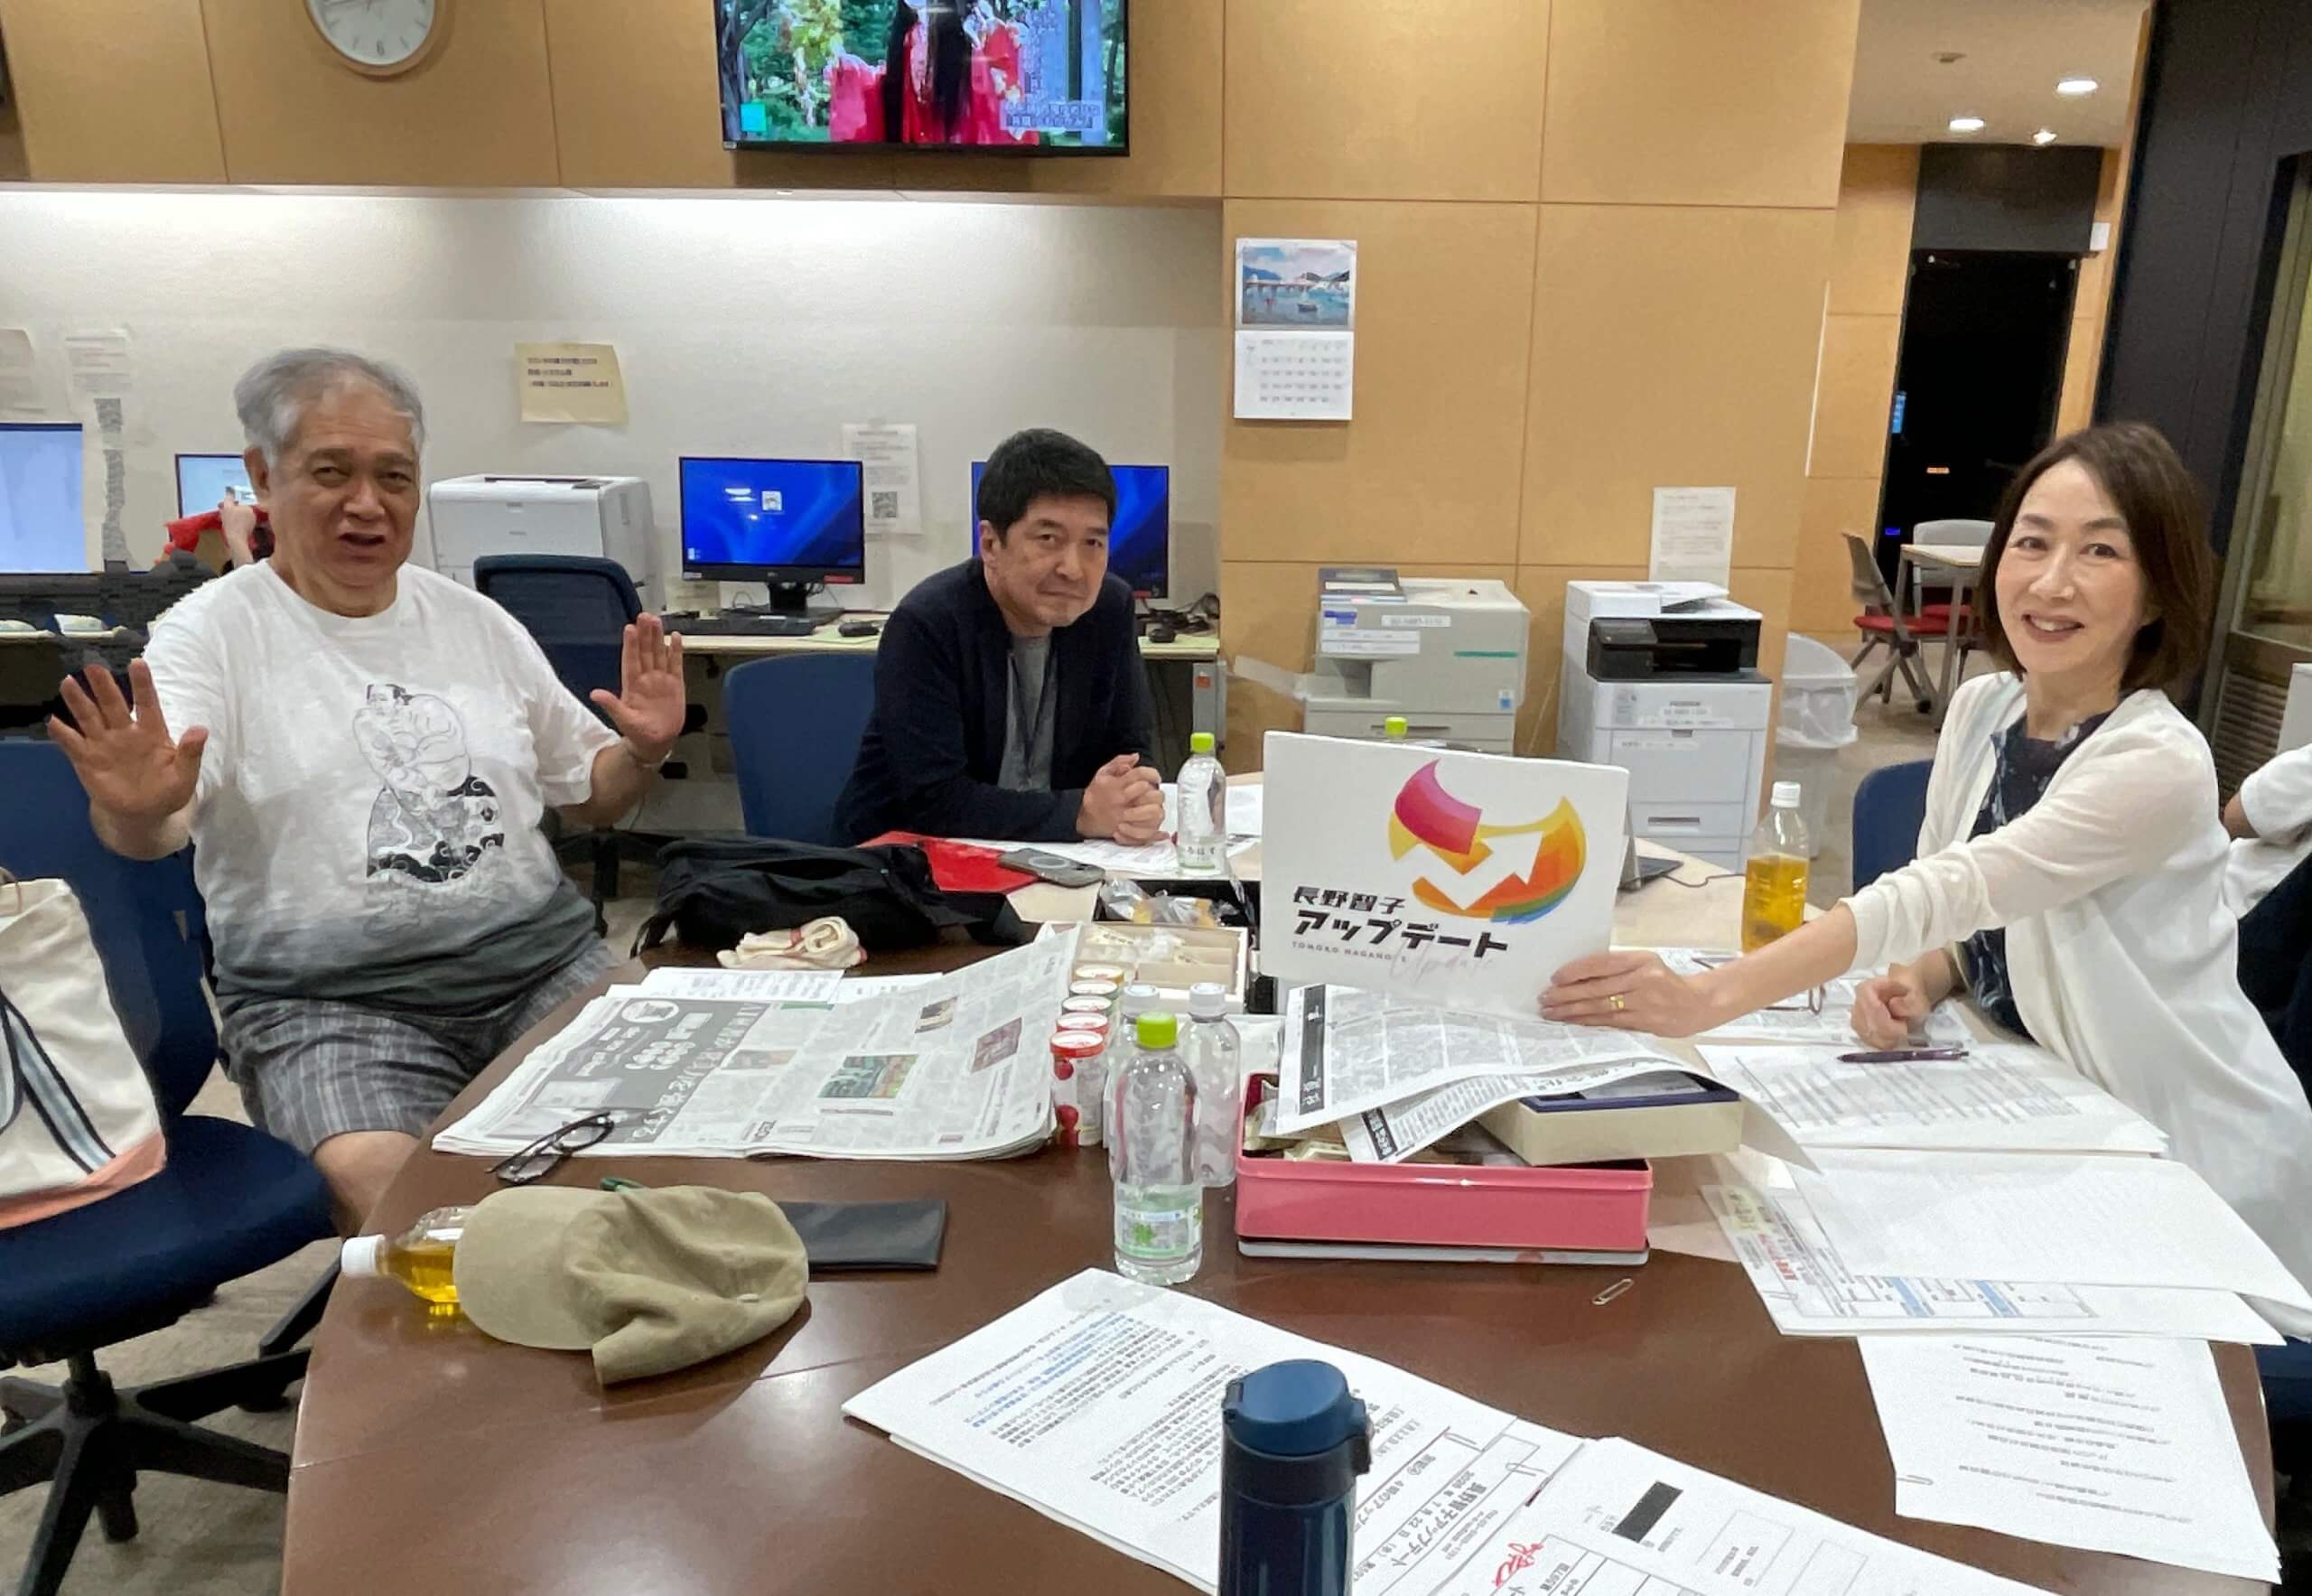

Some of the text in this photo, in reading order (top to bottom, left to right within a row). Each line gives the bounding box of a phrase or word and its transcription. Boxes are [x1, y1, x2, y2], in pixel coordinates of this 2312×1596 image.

[1293, 886, 1406, 915] 長野智子
[1294, 909, 1508, 957] アップデート
